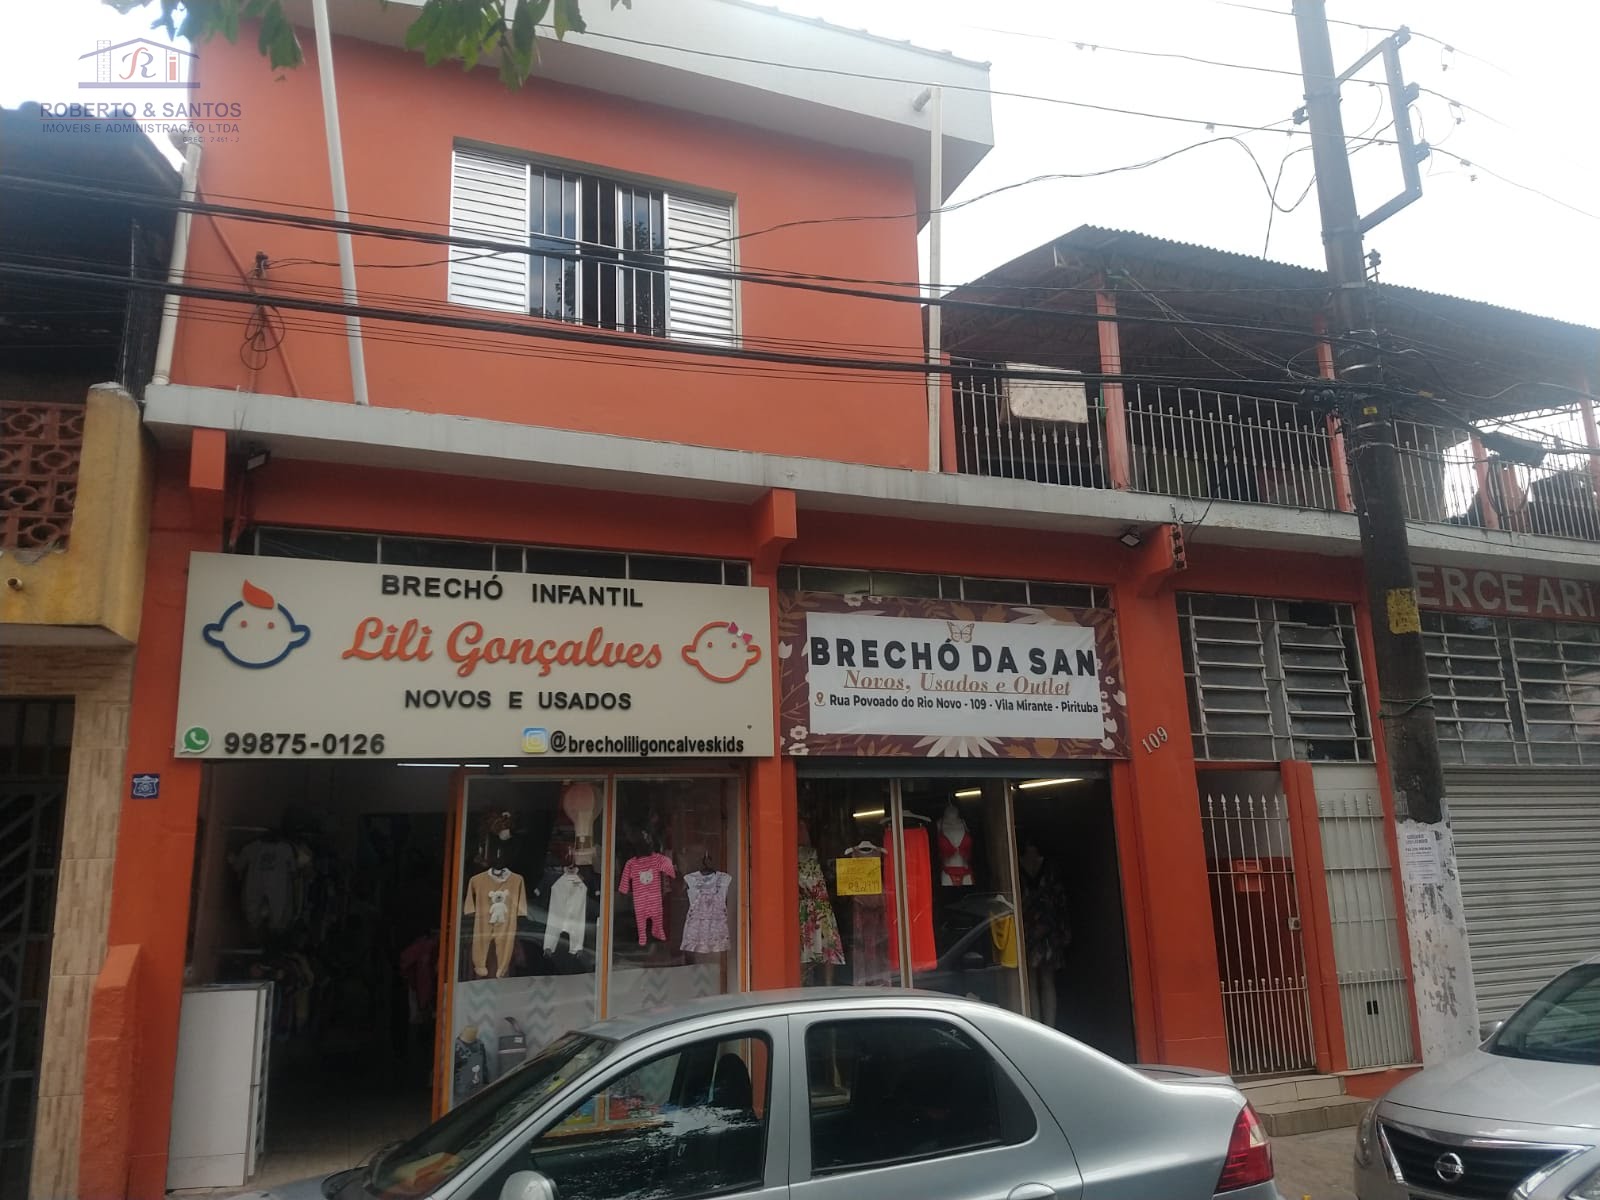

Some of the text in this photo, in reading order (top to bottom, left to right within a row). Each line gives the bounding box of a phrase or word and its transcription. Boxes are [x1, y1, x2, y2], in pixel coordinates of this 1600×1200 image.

[381, 574, 643, 608] BRECHÓ INFANTIL
[341, 616, 662, 678] Lili Gonçalves
[810, 636, 1096, 677] BRECHÓ DA SAN
[844, 669, 1072, 696] Novos, Usados e Outlet
[405, 689, 632, 710] NOVOS E USADOS
[829, 694, 850, 706] Rua
[853, 694, 898, 708] Povoado
[901, 695, 914, 708] do
[917, 695, 932, 708] Rio
[936, 697, 962, 709] Novo
[970, 698, 987, 710] 109
[995, 699, 1014, 711] Vila
[1016, 700, 1053, 712] Mirante
[1061, 701, 1099, 713] Pirituba
[224, 732, 385, 755] 99875-0126
[550, 730, 744, 757] @brecholiligoncalveskids
[1142, 726, 1168, 753] 109
